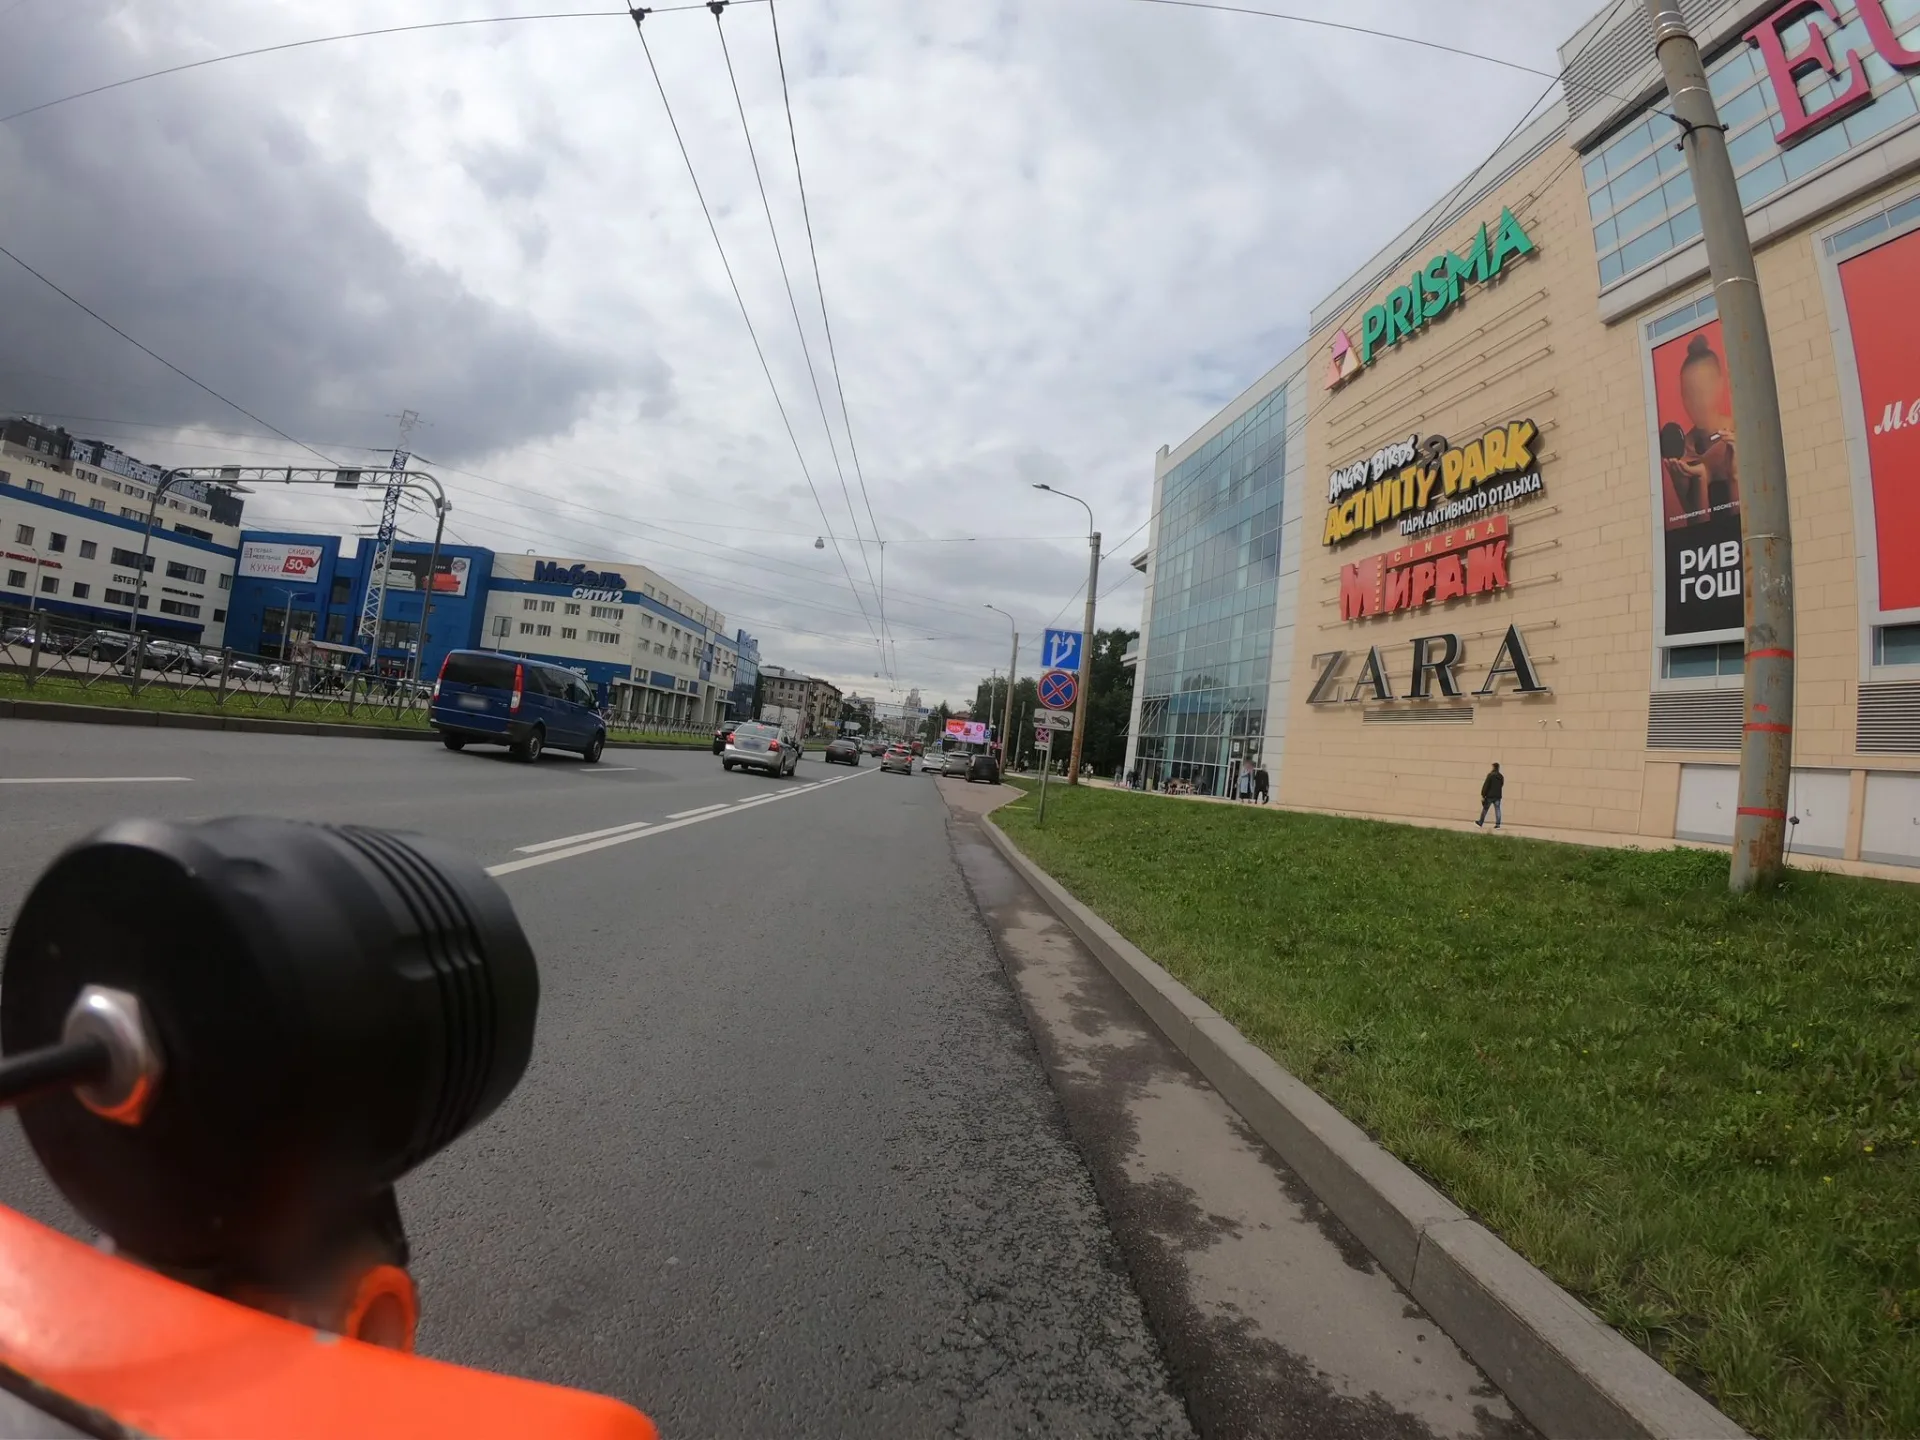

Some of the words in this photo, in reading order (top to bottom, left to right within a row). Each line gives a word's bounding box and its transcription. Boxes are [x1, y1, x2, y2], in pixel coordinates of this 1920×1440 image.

[1361, 205, 1535, 365] PRISMA
[1323, 464, 1438, 545] ACTIVITY
[1441, 419, 1538, 496] PARK
[1328, 459, 1370, 503] ANGRY
[1370, 434, 1417, 481] BIRDS
[1400, 512, 1425, 536] ПАРК
[1426, 490, 1487, 528] АКТИВНОГО
[1488, 473, 1542, 506] ОТДЫХА
[250, 562, 280, 573] КУХНИ
[288, 547, 315, 556] СКИДКИ
[1394, 522, 1495, 562] CINEMA
[1680, 540, 1740, 575] РИВ
[534, 560, 627, 589] Мебель
[1340, 540, 1509, 621] МИРАЖ
[1680, 569, 1740, 603] ГОШ
[1306, 623, 1553, 706] ZARA
